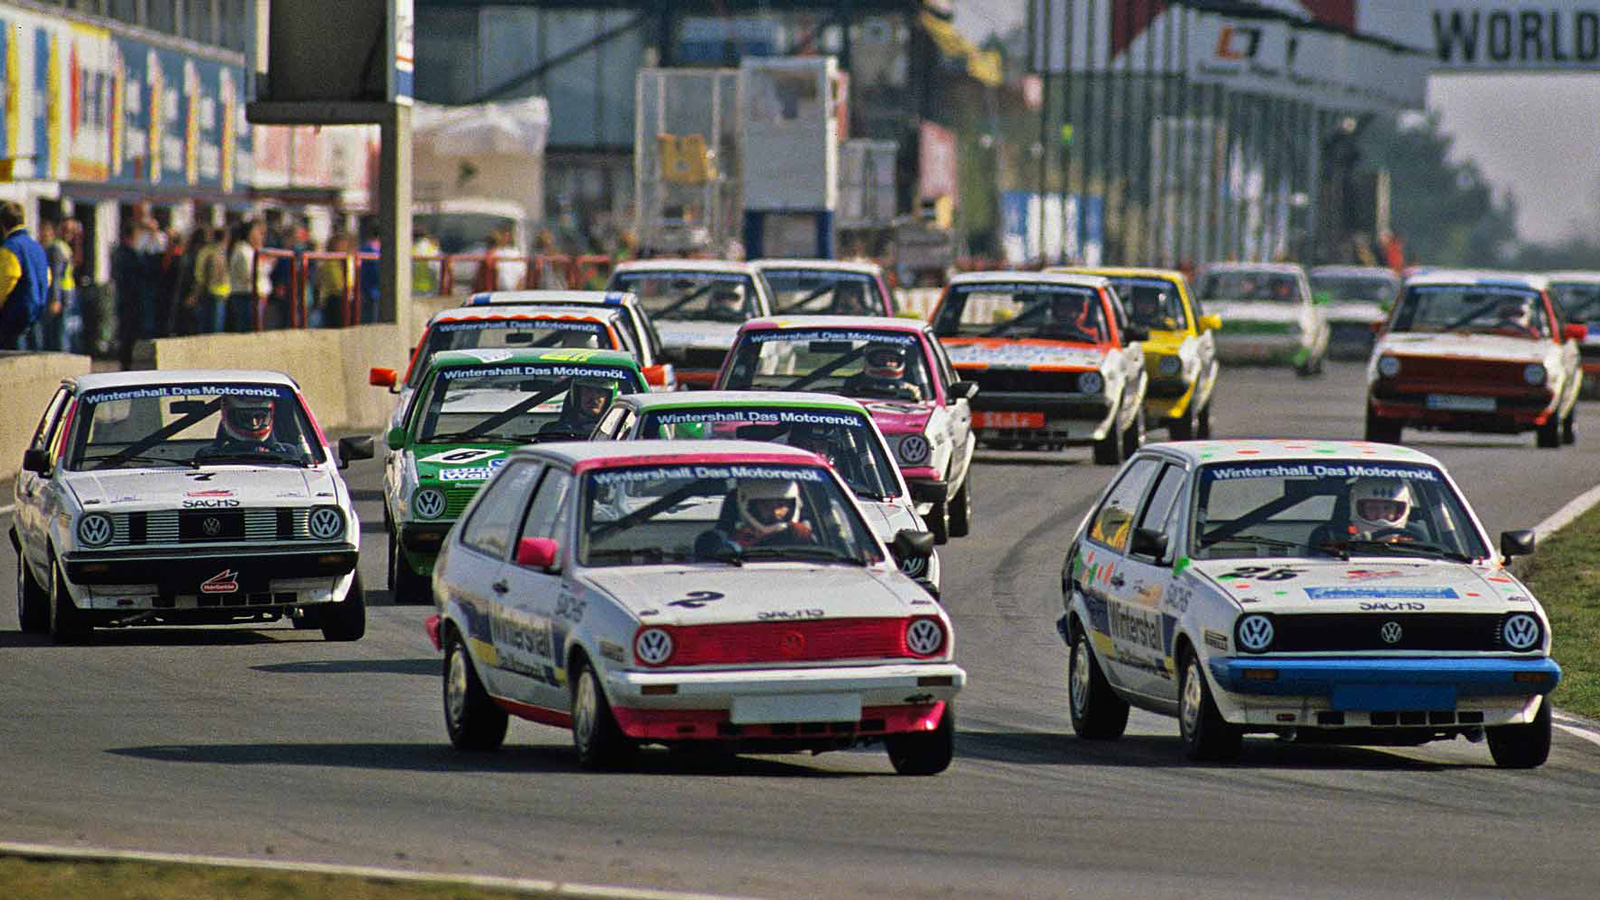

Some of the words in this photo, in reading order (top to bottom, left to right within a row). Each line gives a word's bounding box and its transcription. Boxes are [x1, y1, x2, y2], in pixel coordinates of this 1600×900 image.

[1433, 11, 1600, 62] WORLD
[510, 321, 533, 330] Das
[822, 331, 845, 340] Das
[525, 366, 551, 376] Das
[172, 386, 200, 396] Das
[749, 411, 779, 421] Das
[695, 466, 729, 478] Das
[1314, 465, 1347, 476] Das
[182, 499, 240, 508] SACHS
[667, 590, 725, 609] 2
[1359, 602, 1425, 611] SACHS
